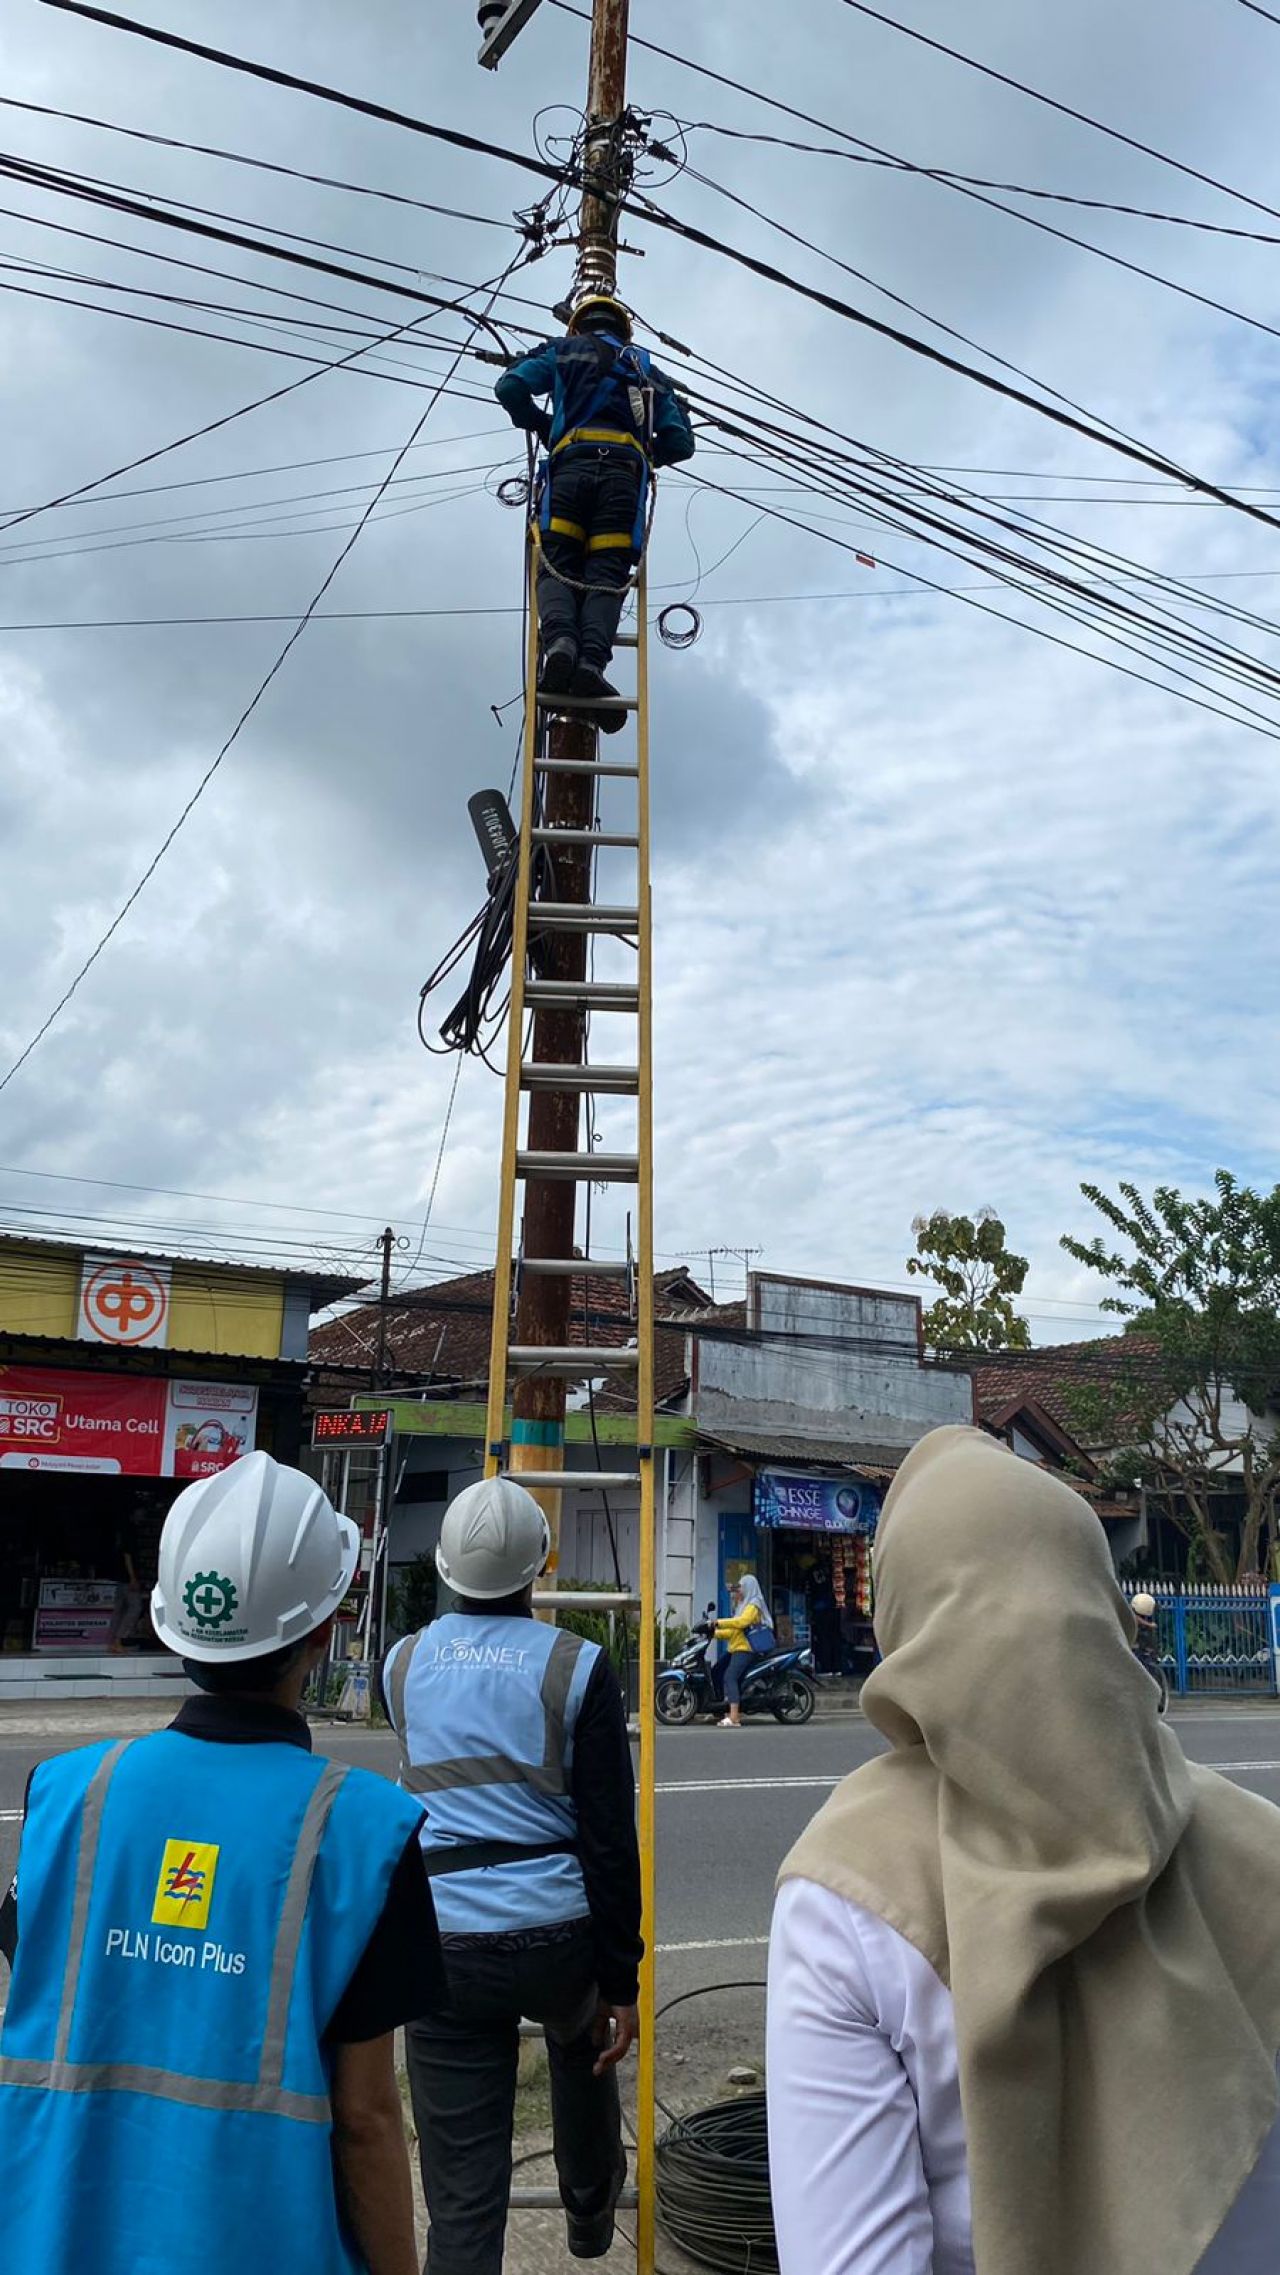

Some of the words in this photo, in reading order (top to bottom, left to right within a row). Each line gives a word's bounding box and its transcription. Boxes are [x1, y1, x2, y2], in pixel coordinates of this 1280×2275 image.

[6, 1401, 51, 1416] TOKO
[13, 1418, 55, 1437] SRC
[65, 1414, 122, 1432] Utama
[125, 1418, 160, 1434] Cell
[200, 1461, 225, 1473] SRC
[788, 1488, 821, 1506] ESSE
[434, 1643, 529, 1667] ICONNET
[105, 1929, 149, 1960] PLN
[155, 1935, 195, 1968] Icon
[201, 1941, 246, 1975] Plus
